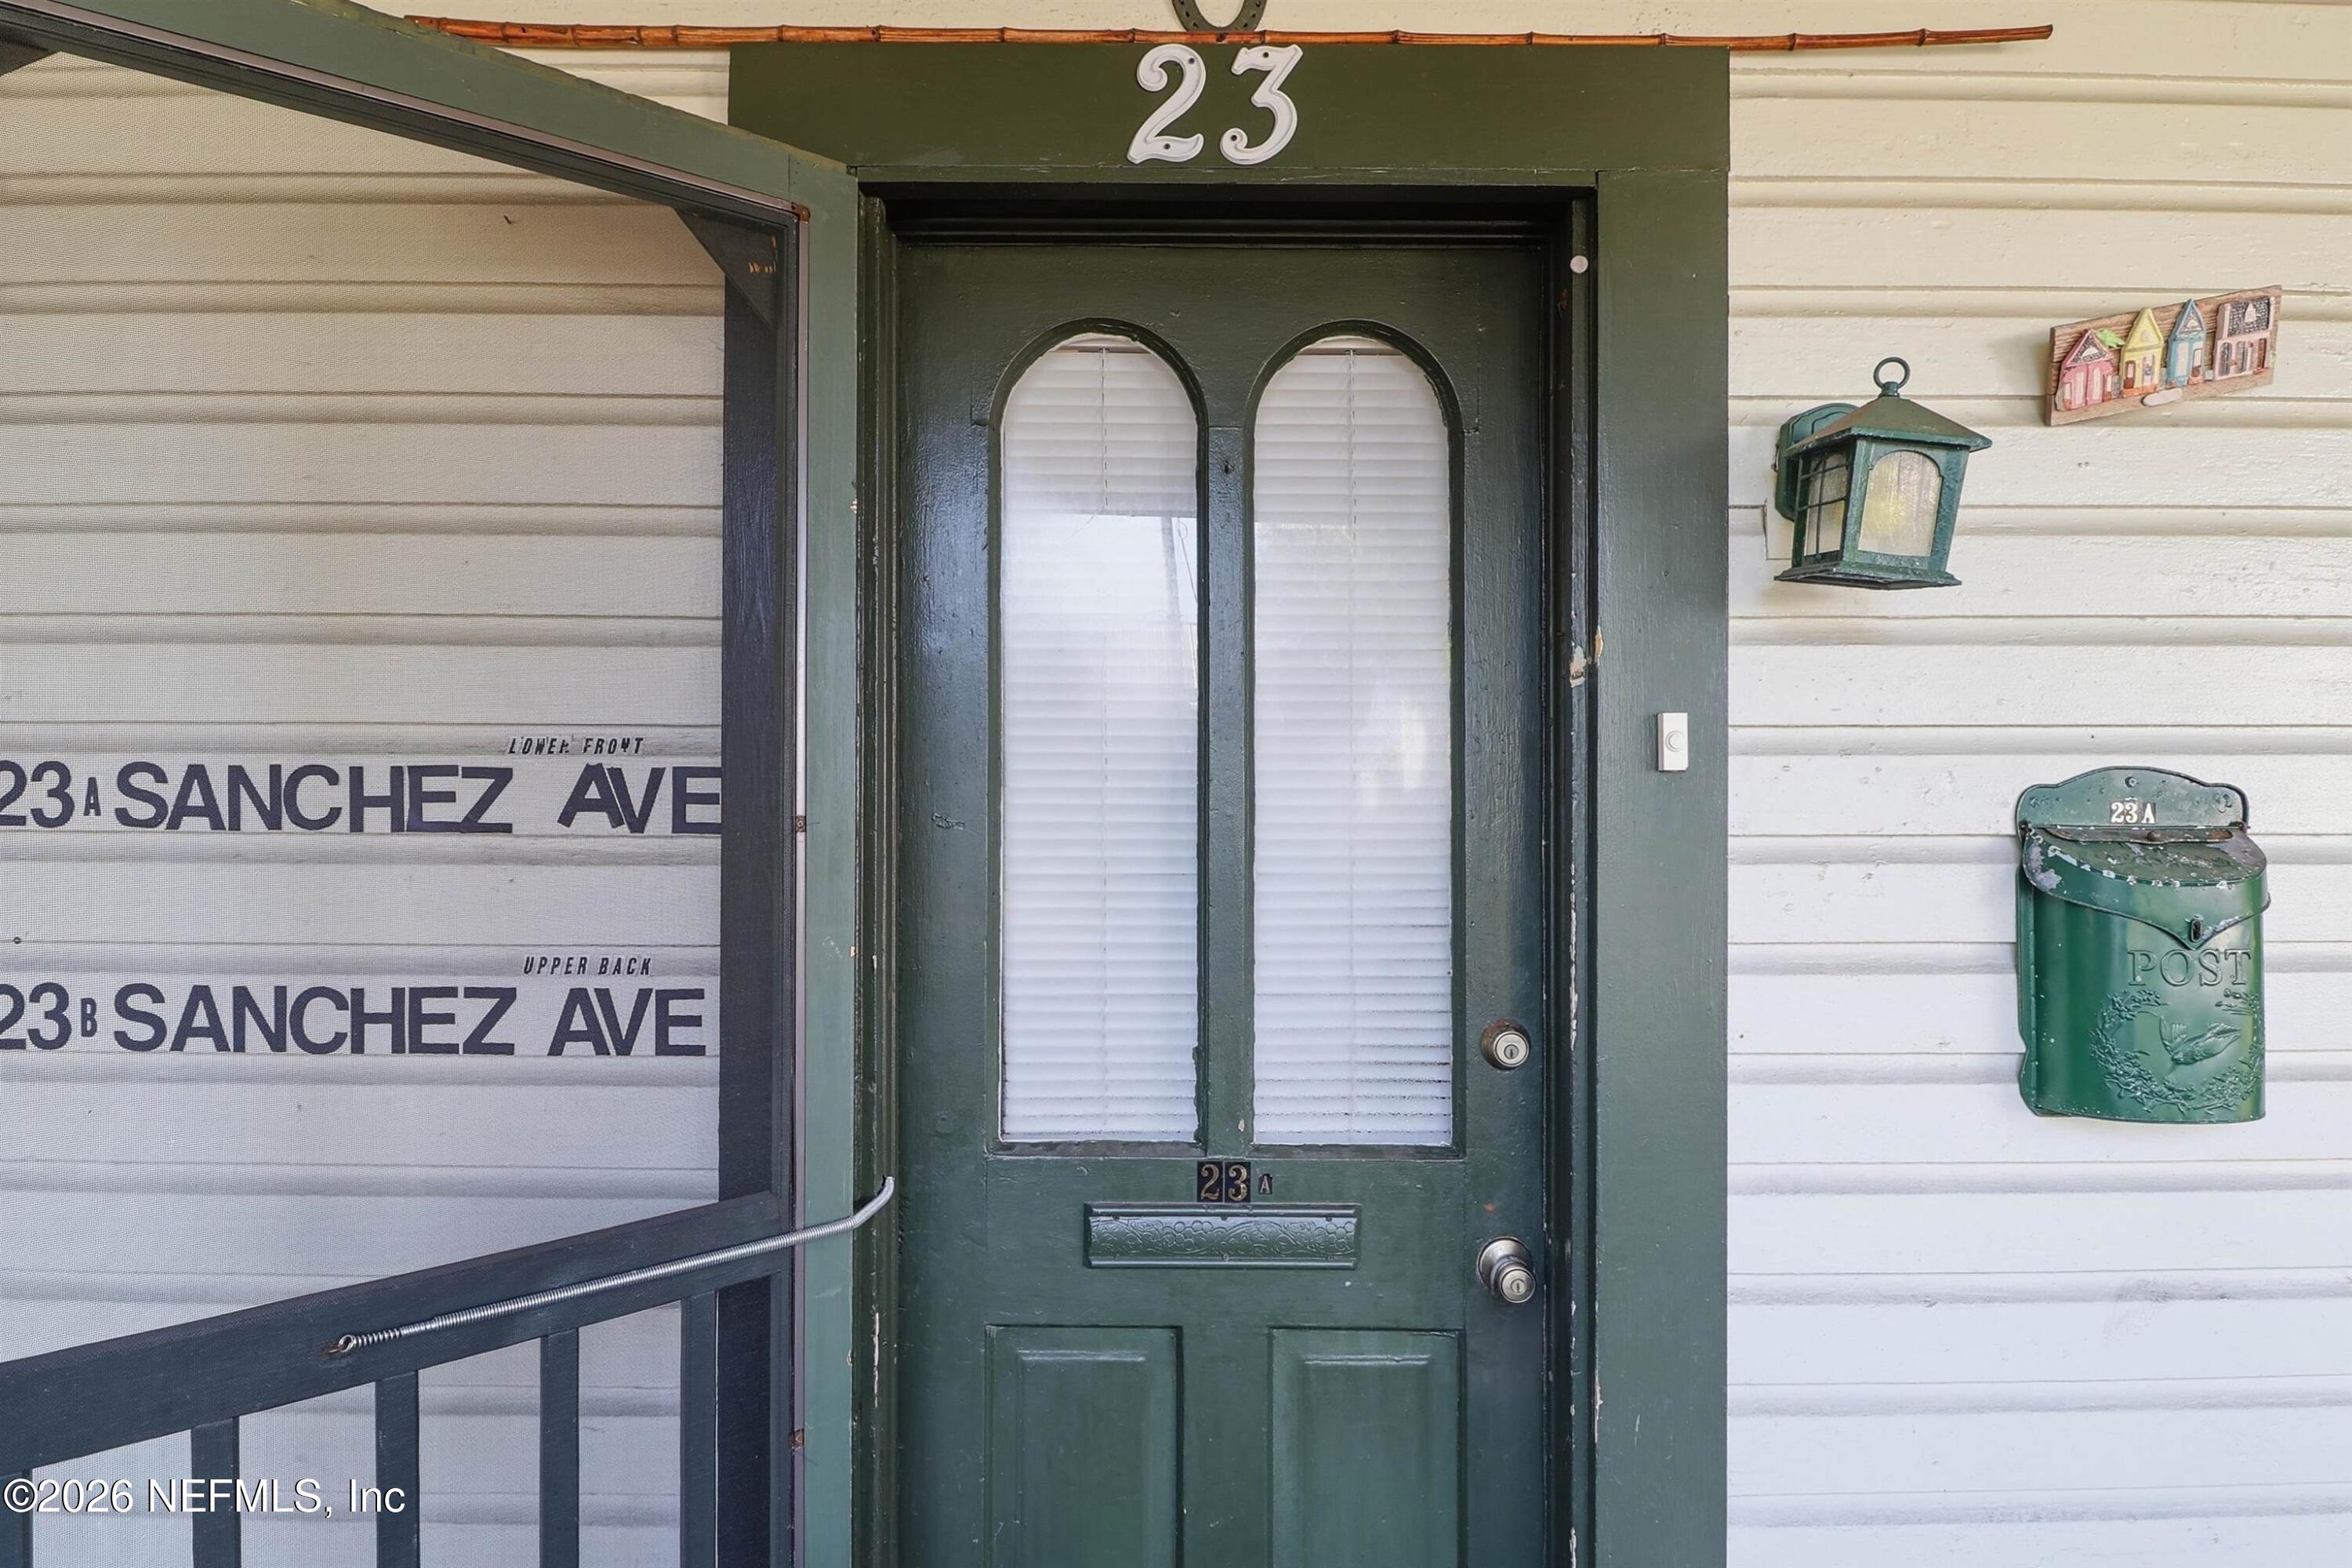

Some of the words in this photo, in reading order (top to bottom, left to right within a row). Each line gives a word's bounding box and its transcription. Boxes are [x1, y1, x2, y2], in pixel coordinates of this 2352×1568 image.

[1127, 43, 1303, 165] 23
[114, 760, 513, 833] SANCHEZ
[557, 763, 721, 833] AVE
[524, 956, 589, 975] UPPER
[597, 957, 652, 975] BACK
[2127, 948, 2252, 987] POST
[114, 982, 517, 1056] SANCHEZ
[547, 987, 706, 1057] AVE
